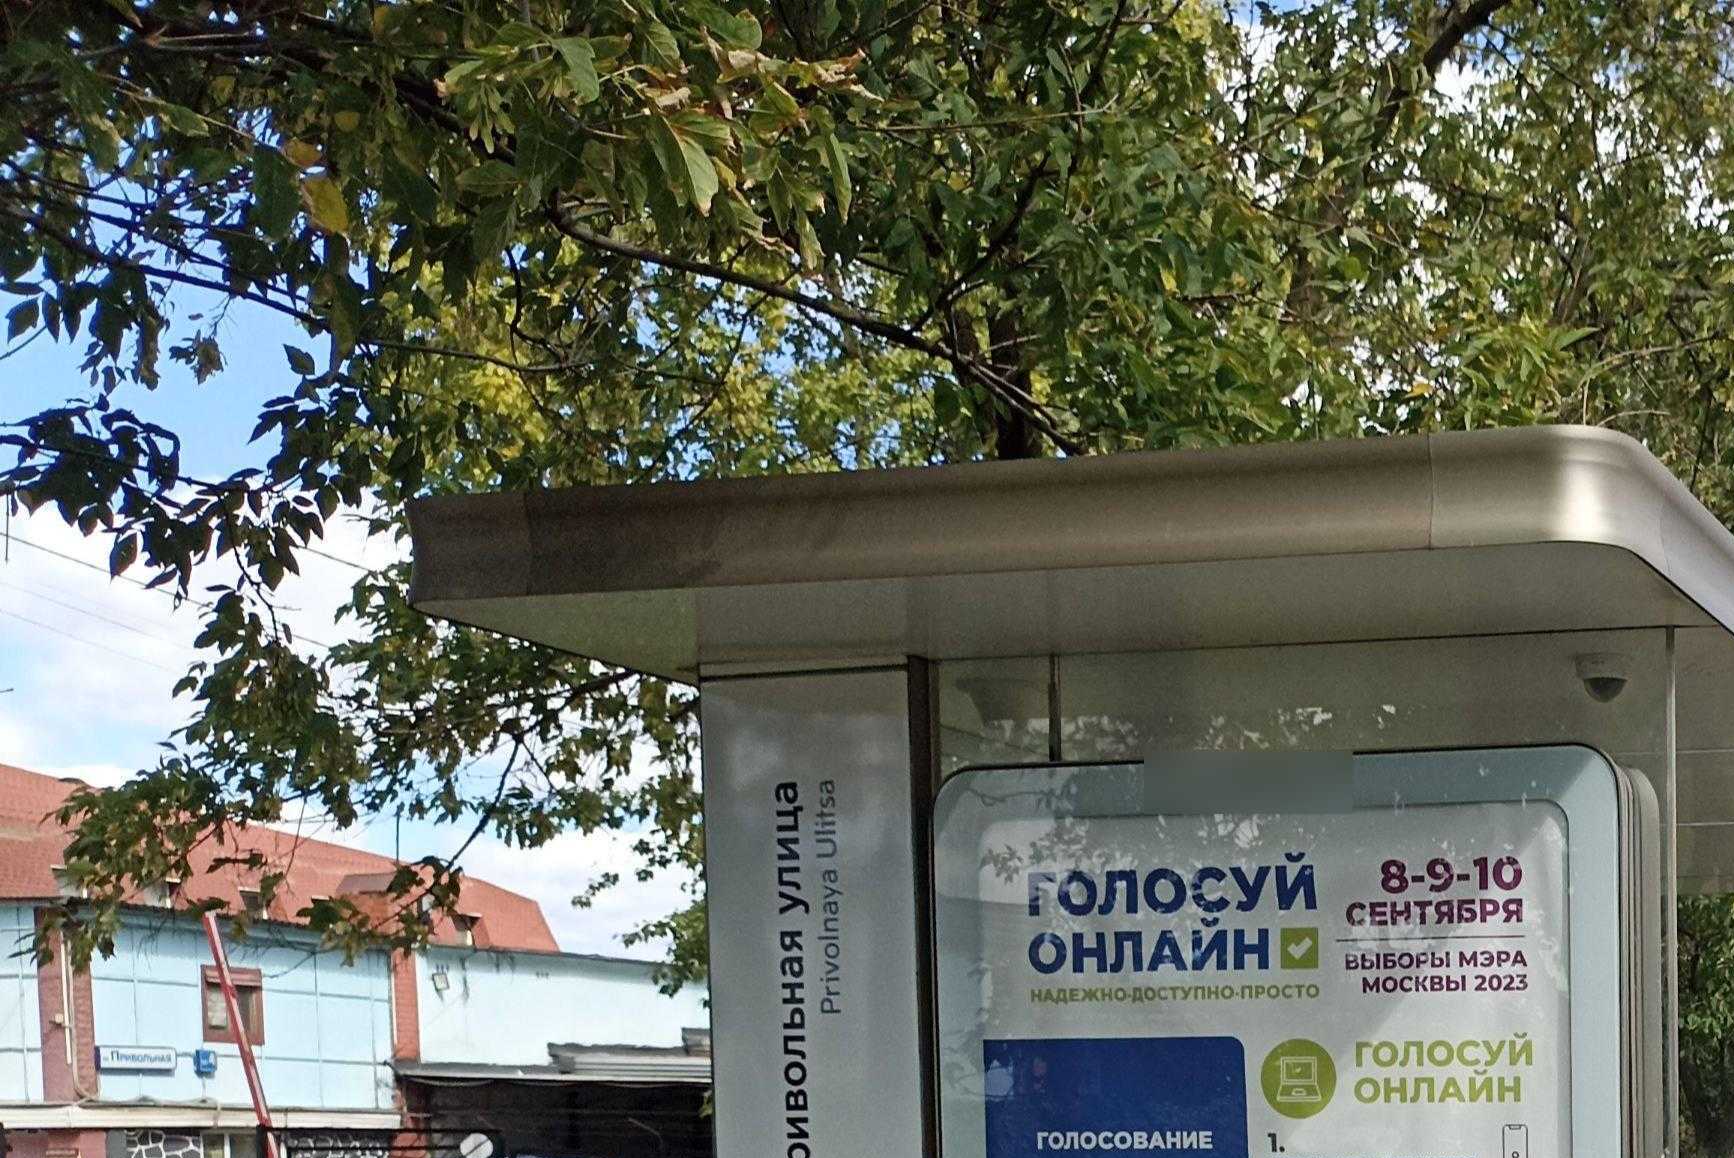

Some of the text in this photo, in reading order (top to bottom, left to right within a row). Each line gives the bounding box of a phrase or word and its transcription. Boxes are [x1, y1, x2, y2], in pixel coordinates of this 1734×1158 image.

[774, 781, 810, 915] улица
[1028, 851, 1317, 916] ГОЛОСУЙ
[1381, 856, 1523, 894] 8-9-10
[814, 779, 843, 1016] Privolnaya Ulitsa
[1345, 898, 1524, 926] СЕНТЯБРЯ
[1028, 917, 1269, 974] ОНЛАЙН
[1345, 951, 1528, 971] ВЫБОРЫ МЭРА
[1362, 974, 1529, 993] МОСКВЫ 2023
[1355, 1032, 1534, 1068] ГОЛОСУЙ
[1353, 1068, 1522, 1104] ОНЛАЙН
[1037, 1131, 1214, 1150] ГОЛОСОВАНИЕ
[1267, 1133, 1286, 1153] 1.
